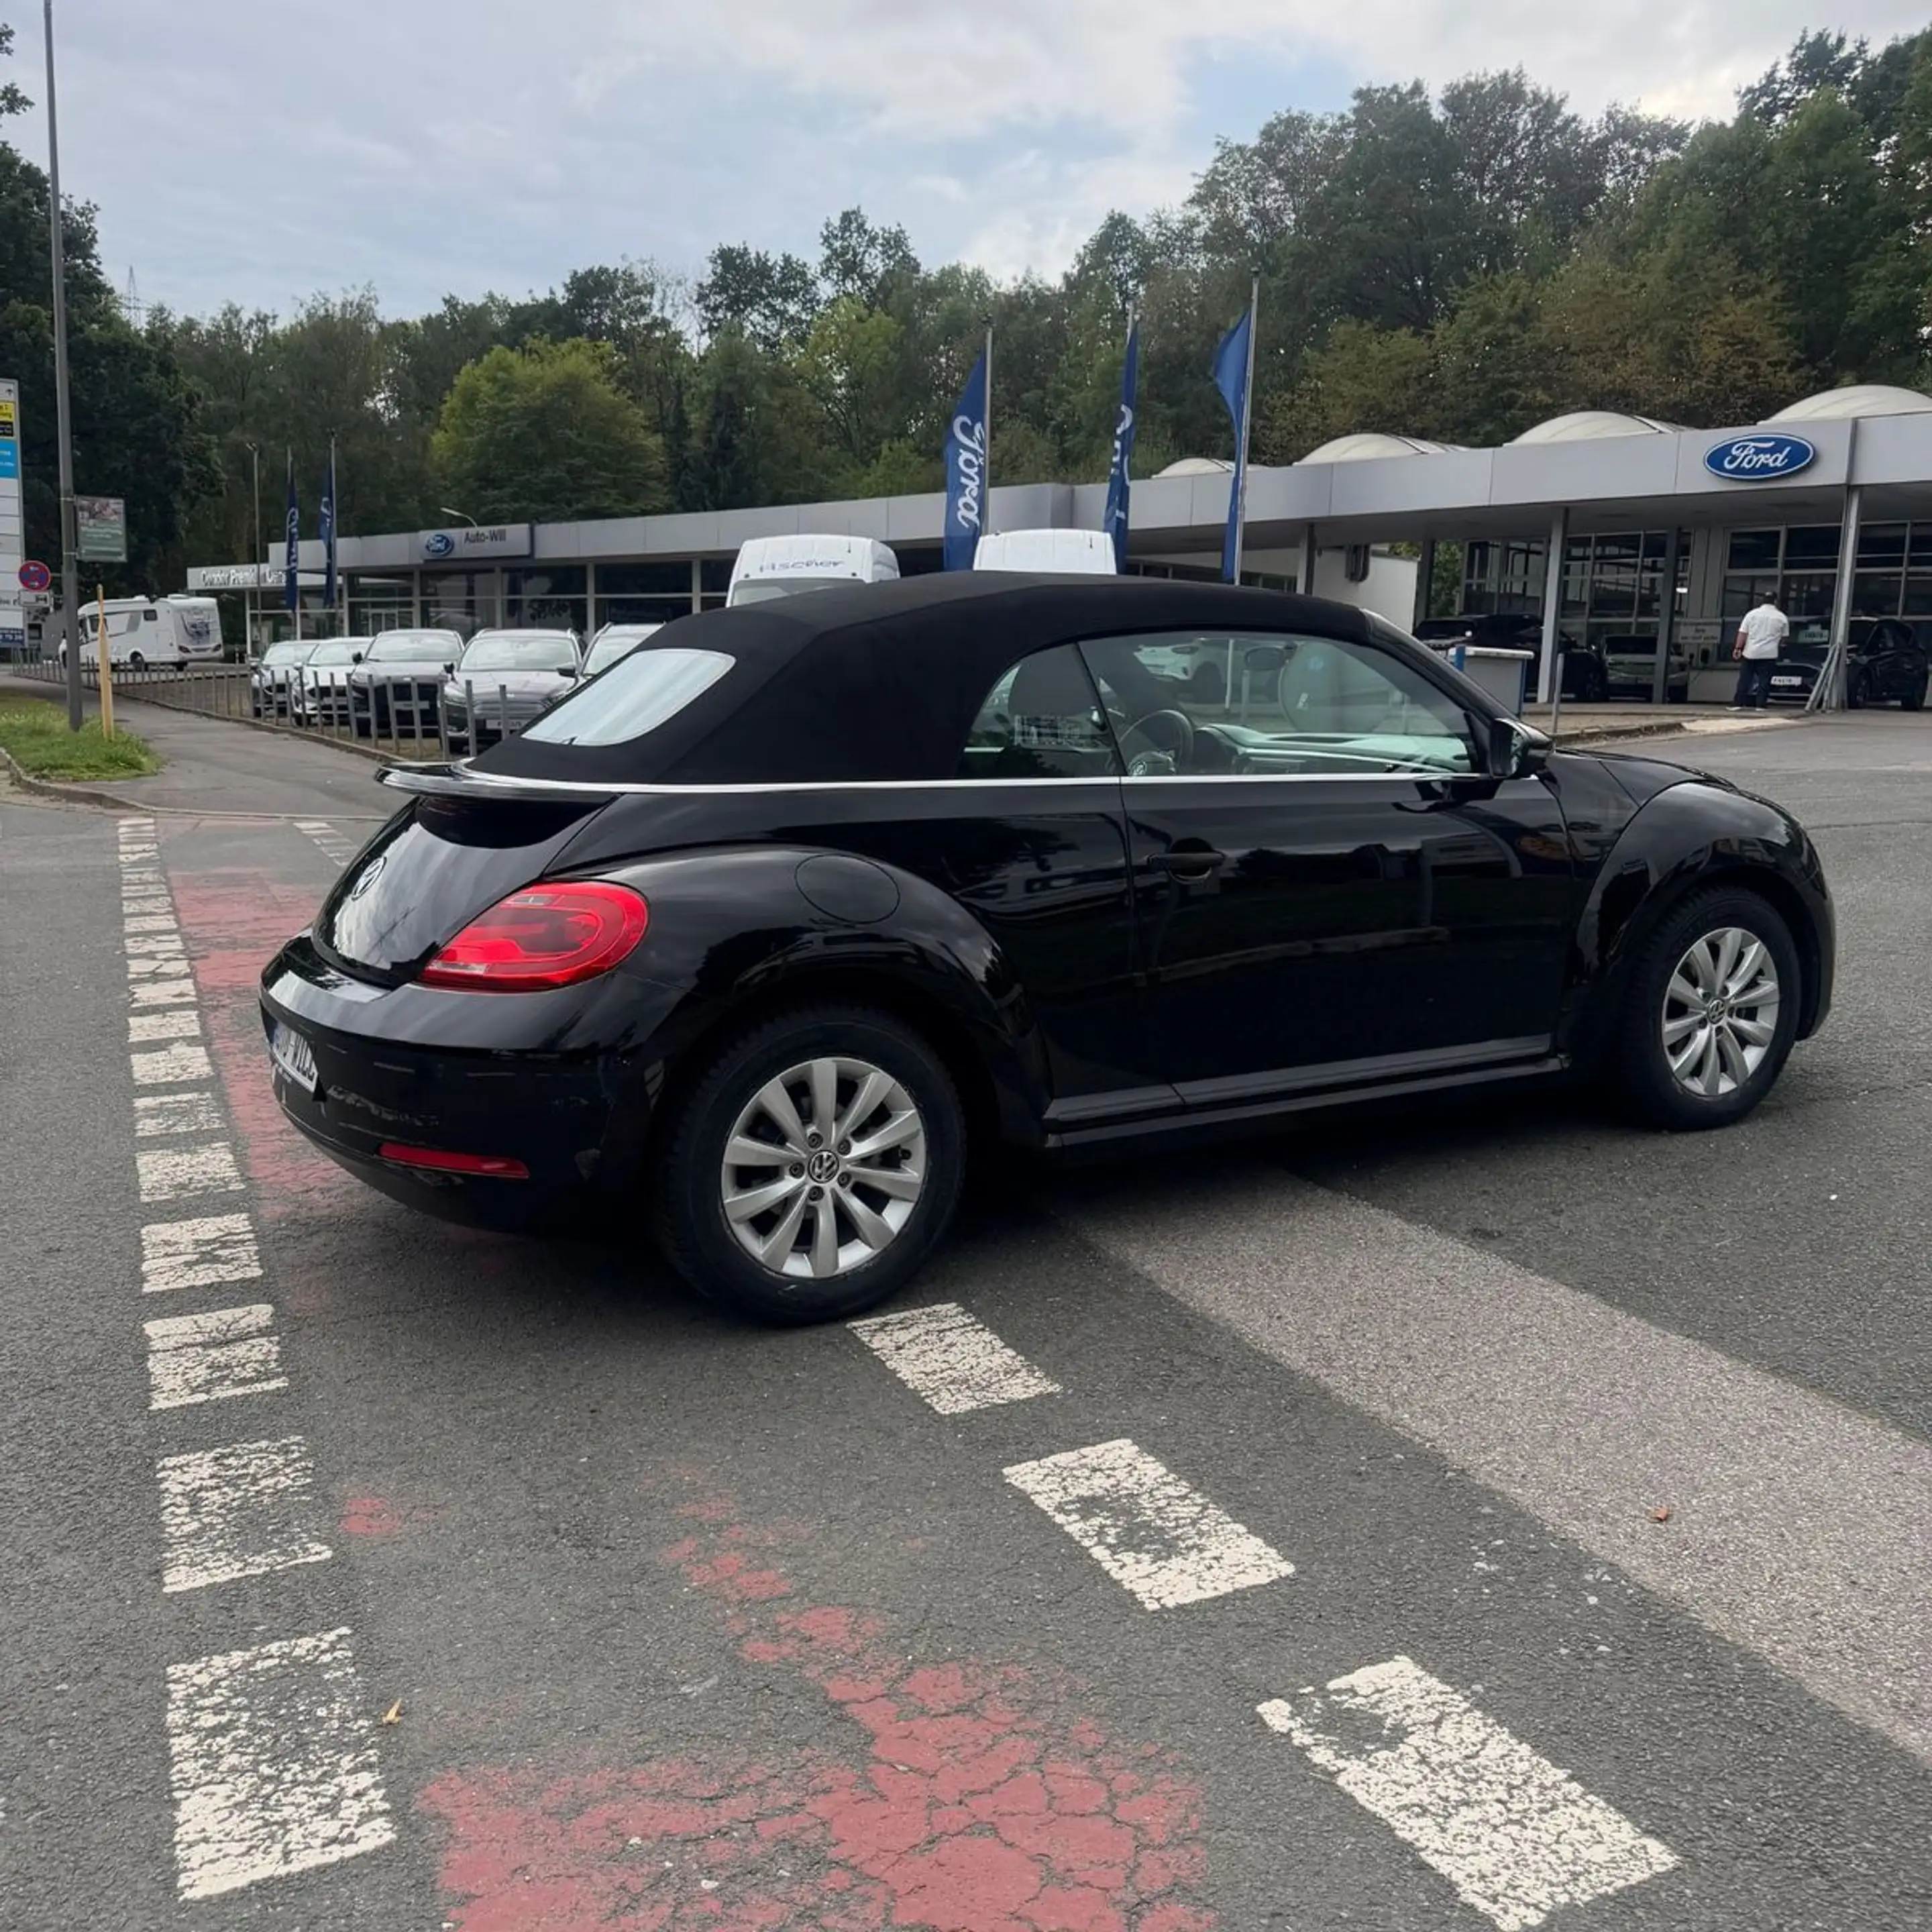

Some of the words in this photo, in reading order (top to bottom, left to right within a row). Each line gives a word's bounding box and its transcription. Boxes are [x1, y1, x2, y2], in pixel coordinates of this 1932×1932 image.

[1723, 441, 1791, 470] Ford
[953, 415, 985, 528] Ford
[464, 528, 506, 544] Auto-Will
